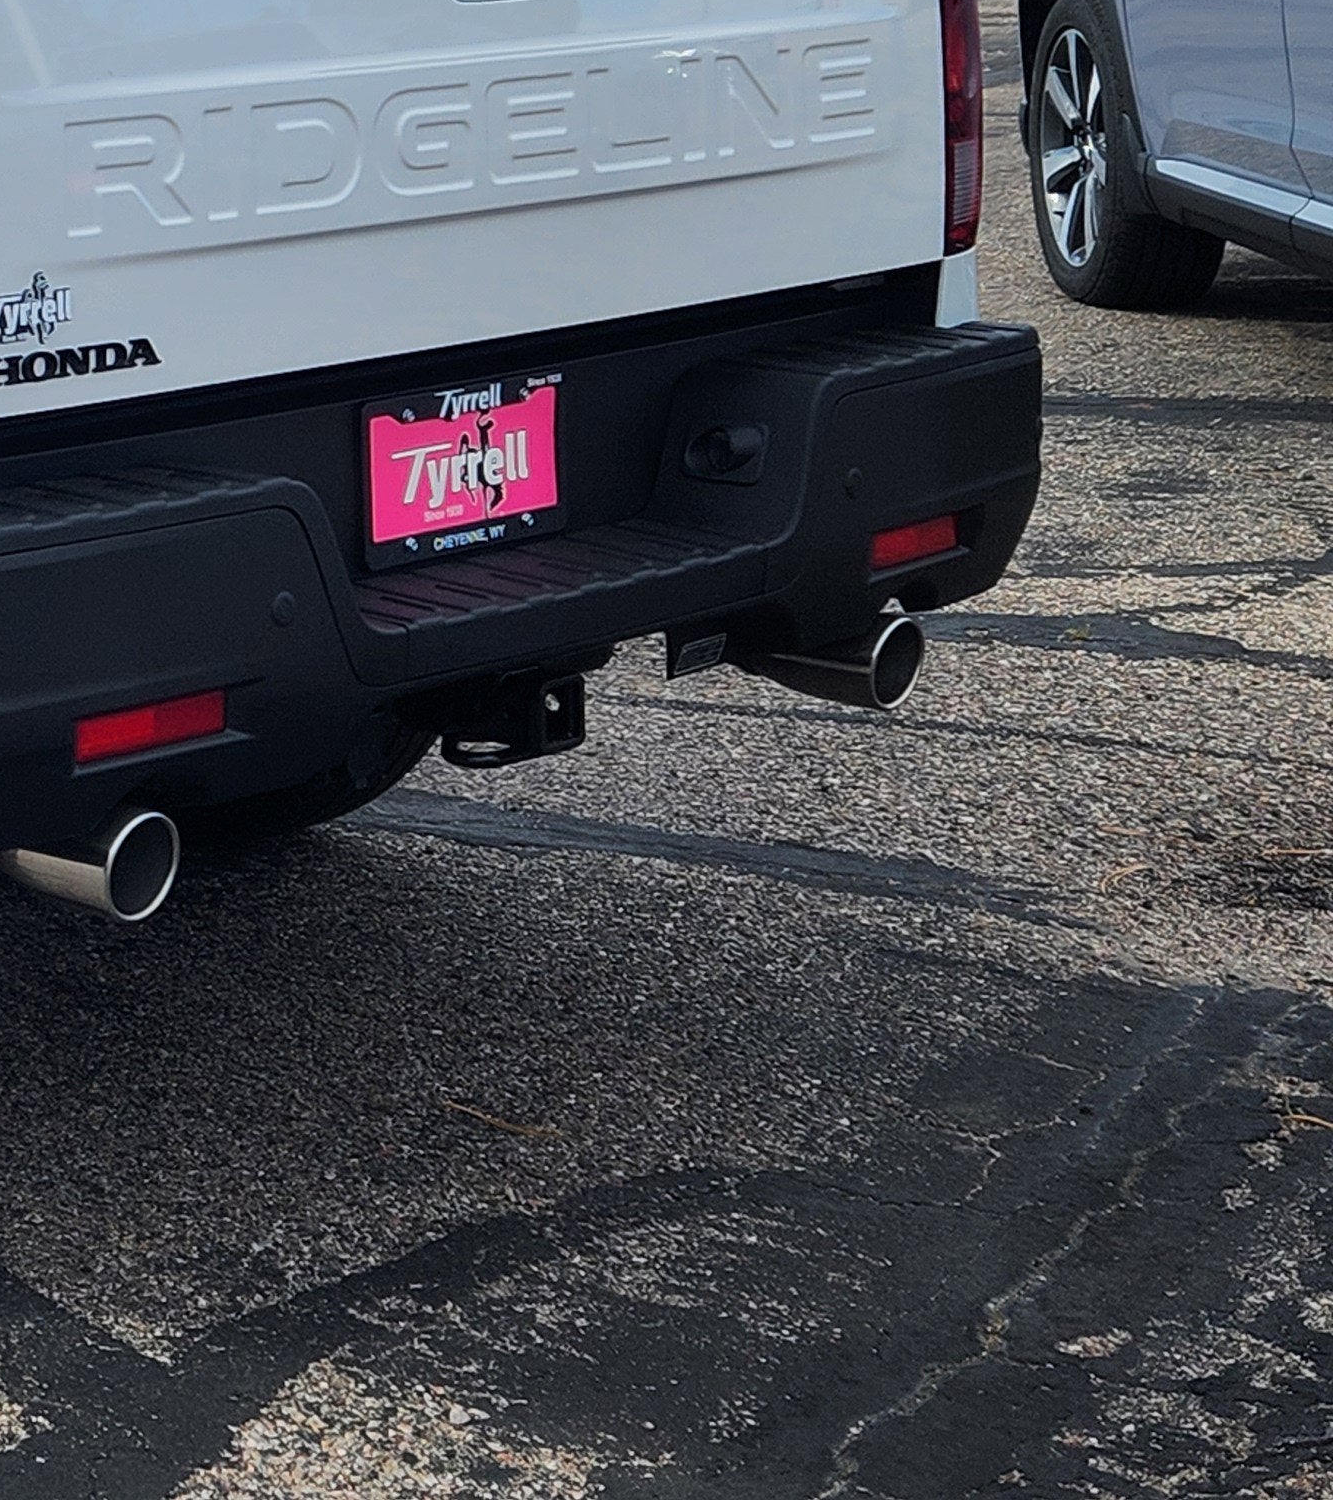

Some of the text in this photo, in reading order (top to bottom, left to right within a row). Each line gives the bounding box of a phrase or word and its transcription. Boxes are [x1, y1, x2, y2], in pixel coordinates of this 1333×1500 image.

[63, 38, 876, 239] RIDGELINE
[434, 382, 502, 420] Tyrrell
[391, 430, 529, 509] Tyrrell
[488, 523, 507, 540] WY
